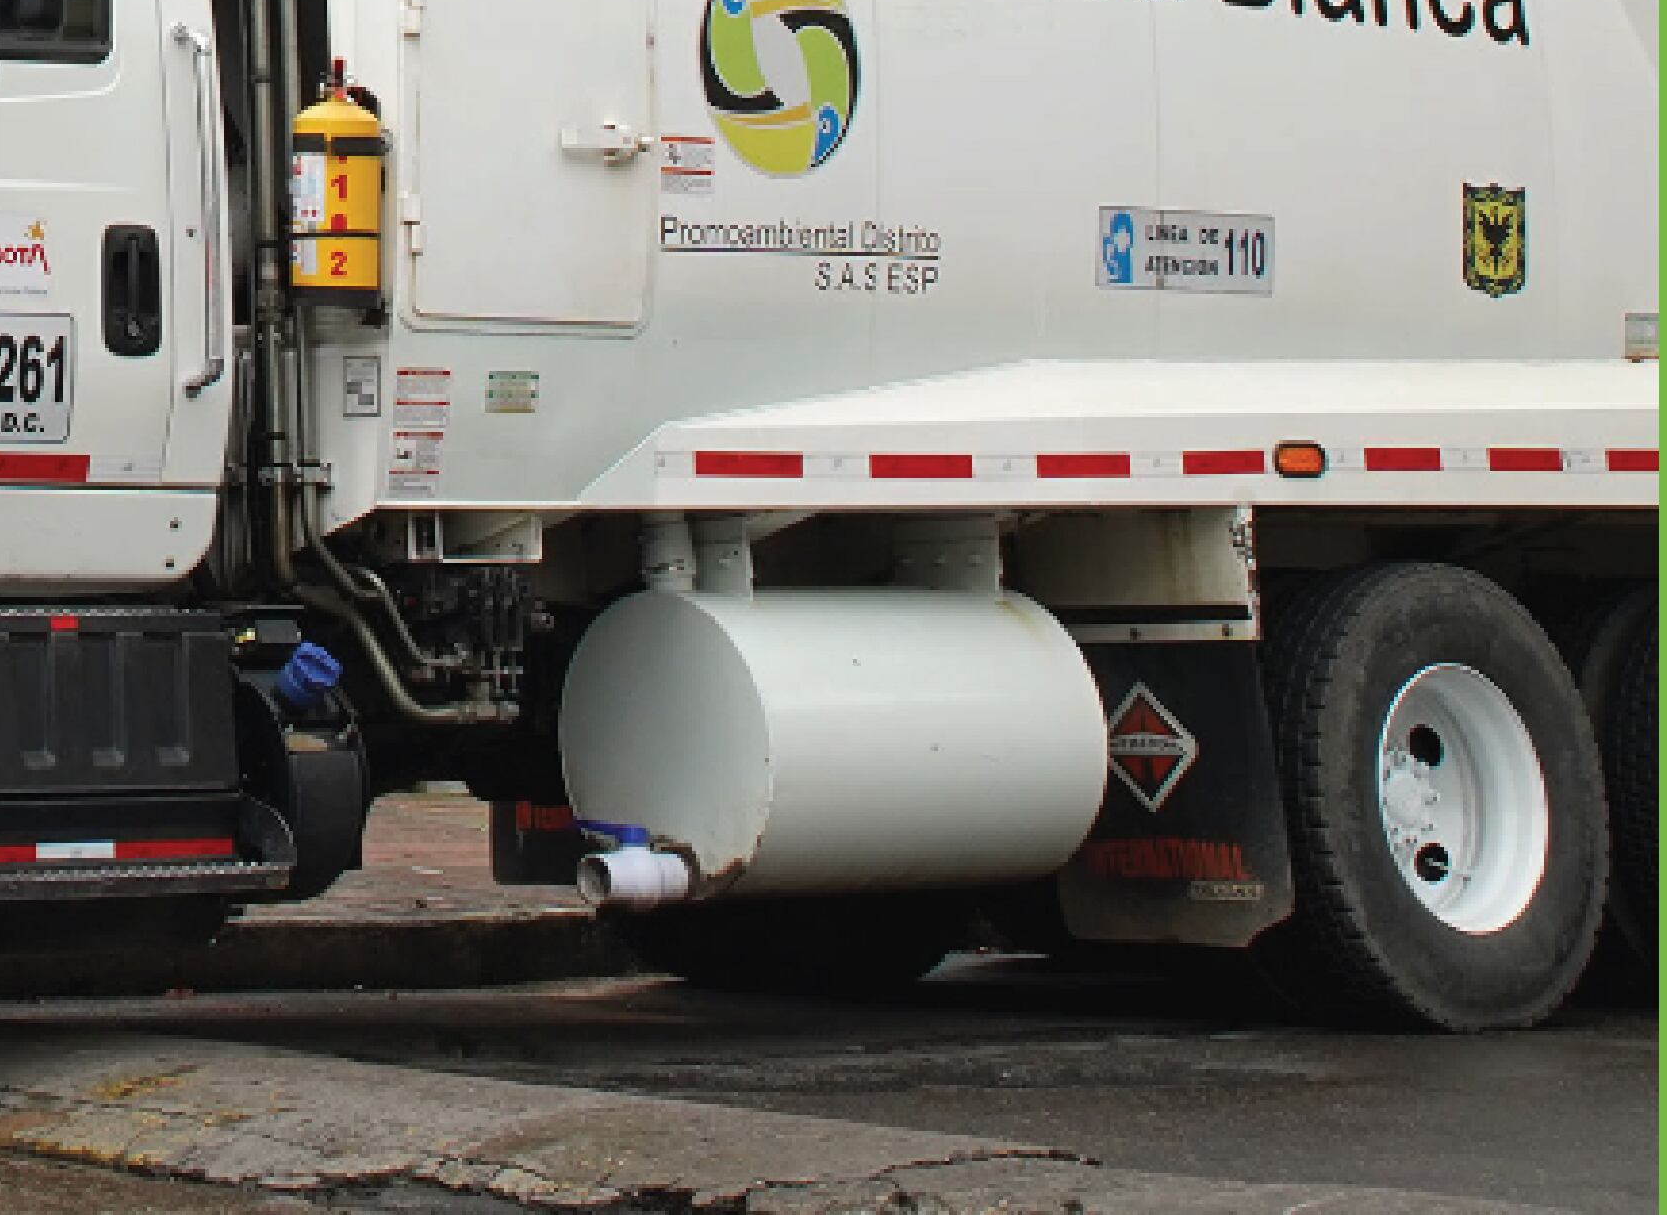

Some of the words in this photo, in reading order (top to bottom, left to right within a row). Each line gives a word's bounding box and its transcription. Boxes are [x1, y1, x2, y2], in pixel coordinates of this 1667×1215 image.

[660, 216, 854, 249] Promoambiental
[860, 220, 941, 253] Distrito
[1224, 228, 1266, 280] 110
[887, 262, 939, 294] ESP
[0, 413, 46, 434] D.C.
